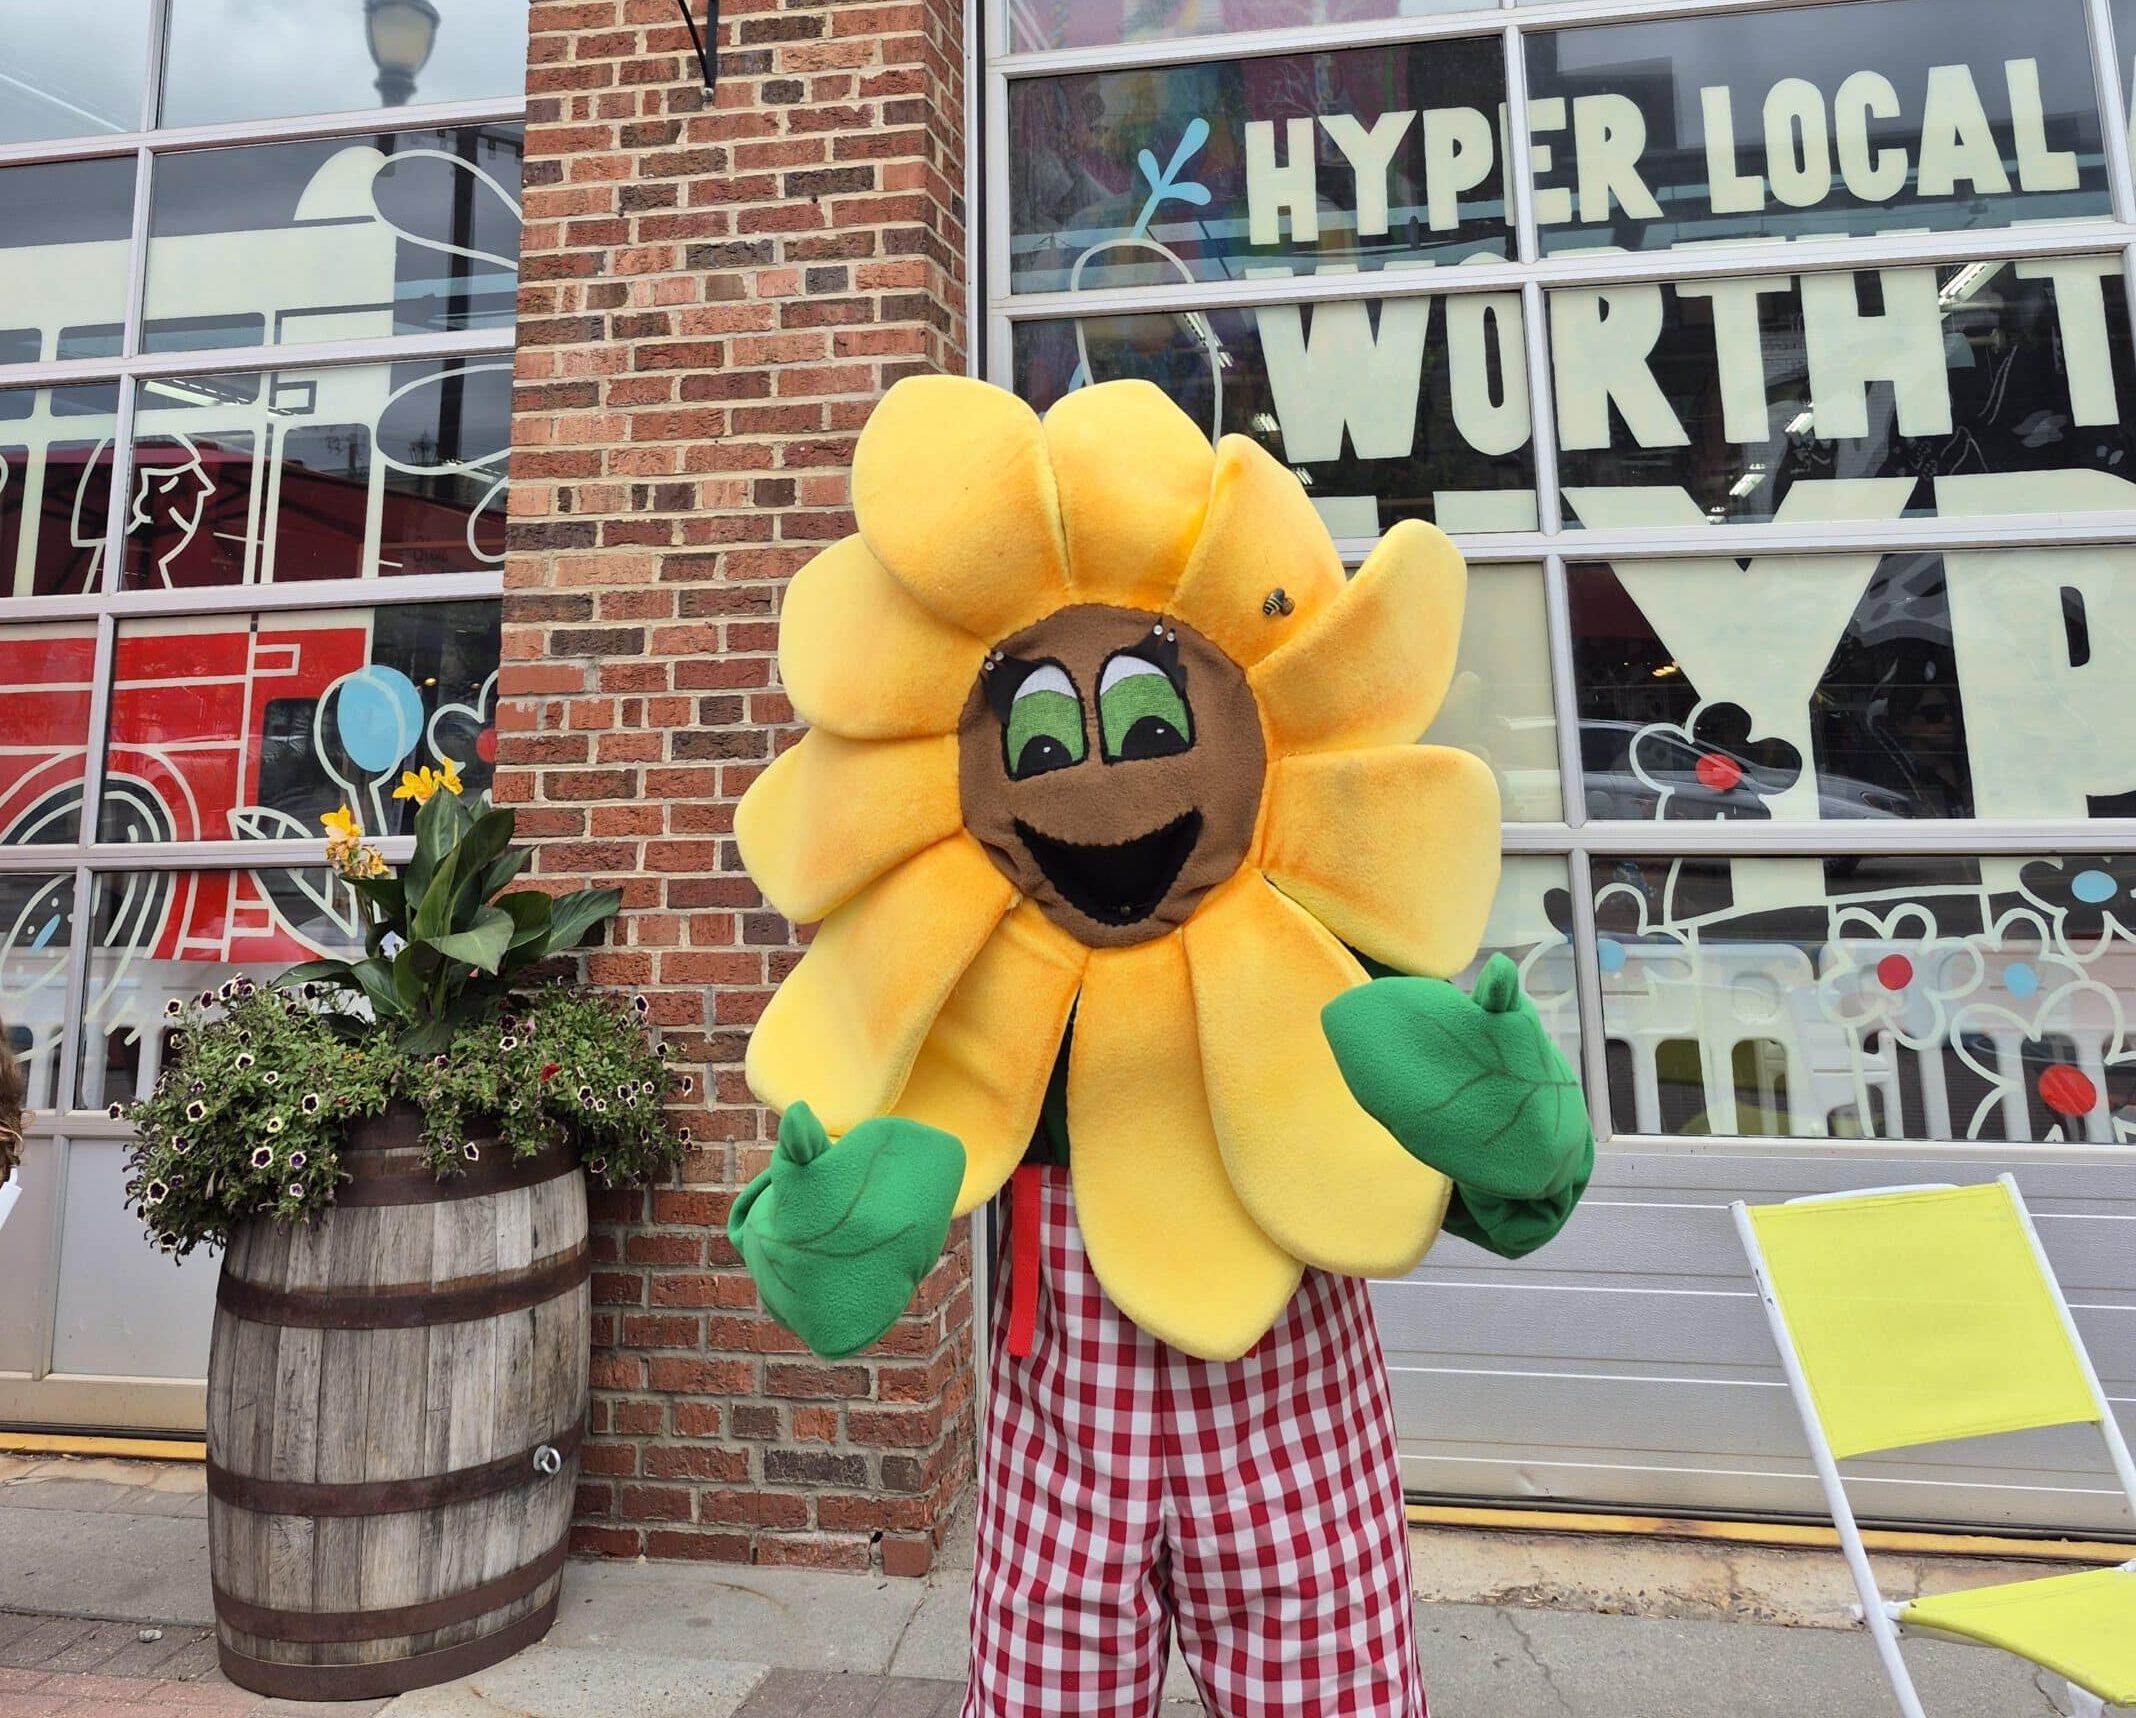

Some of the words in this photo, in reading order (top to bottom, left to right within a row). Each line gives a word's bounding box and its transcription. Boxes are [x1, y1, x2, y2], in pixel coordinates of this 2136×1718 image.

[1245, 94, 1664, 245] HYPER
[1700, 58, 2080, 213] LOCAL
[1245, 228, 1953, 463] WORTH
